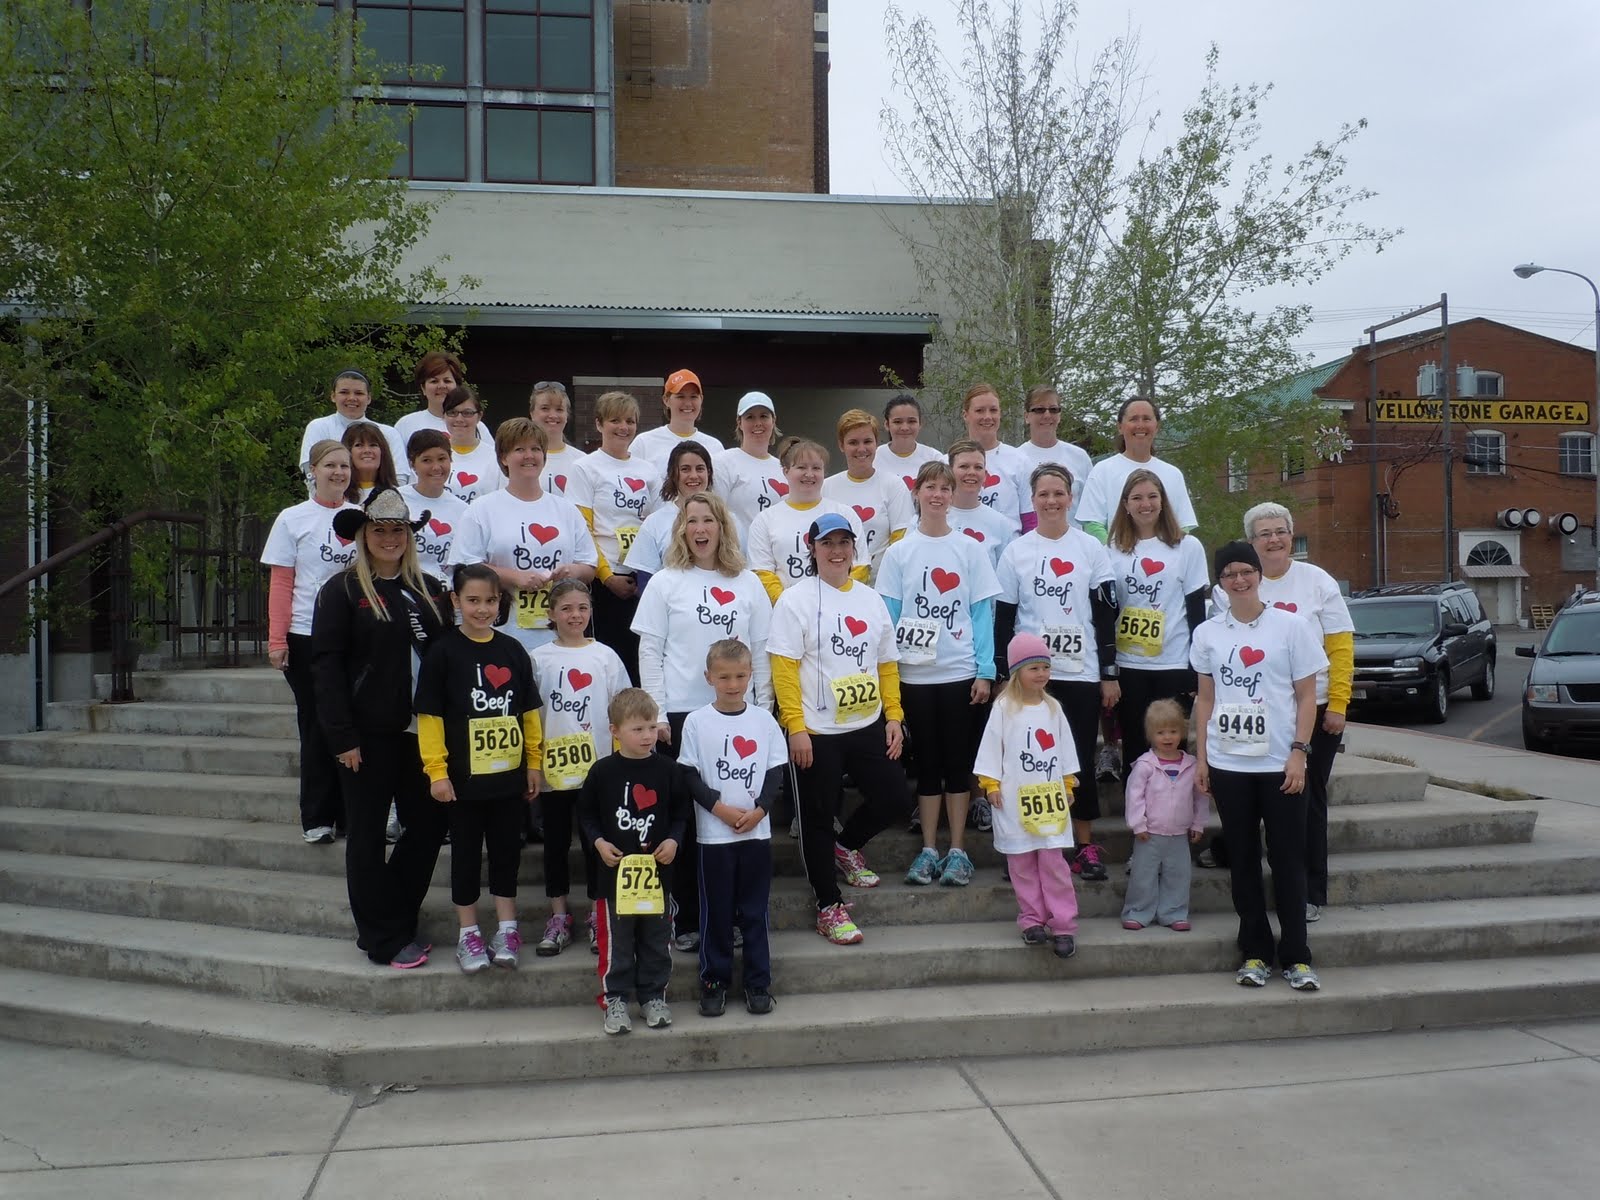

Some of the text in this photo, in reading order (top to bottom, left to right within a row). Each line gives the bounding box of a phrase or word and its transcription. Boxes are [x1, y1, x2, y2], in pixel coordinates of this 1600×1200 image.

[1500, 404, 1574, 421] GARAGE
[447, 469, 455, 485] i
[548, 473, 552, 494] i
[617, 475, 623, 489] i
[761, 476, 768, 494] i
[444, 486, 476, 505] ef
[613, 489, 647, 517] Beef
[977, 491, 999, 508] ef
[328, 528, 332, 544] i
[521, 522, 526, 543] i
[795, 531, 801, 554] i
[320, 543, 357, 568] Beef
[415, 533, 451, 563] Beef
[513, 545, 562, 571] Beef
[786, 554, 814, 579] Be
[1041, 556, 1047, 576] i
[1132, 555, 1139, 574] i
[923, 566, 929, 592] i
[1033, 576, 1073, 606] Beef
[1125, 575, 1163, 603] Beef
[519, 590, 550, 609] 572
[703, 585, 708, 604] i
[696, 604, 738, 635] Beef
[838, 613, 842, 633] i
[915, 593, 961, 630] Beef
[408, 609, 428, 641] tana
[896, 626, 936, 648] 9427
[1120, 616, 1161, 639] 5626
[831, 633, 868, 667] Beef
[1229, 644, 1238, 664] i
[476, 663, 483, 687] i
[558, 666, 565, 689] i
[1220, 664, 1263, 698] Beef
[471, 687, 514, 716] Beef
[550, 690, 591, 722] Beef
[836, 682, 877, 708] 2322
[1219, 714, 1266, 736] 9448
[474, 727, 520, 751] 5620
[724, 734, 730, 757] i
[1026, 726, 1032, 750] i
[546, 743, 592, 769] 5580
[1020, 751, 1058, 782] Beef
[716, 758, 757, 789] Beef
[624, 781, 630, 806] i
[1020, 792, 1066, 817] 5616
